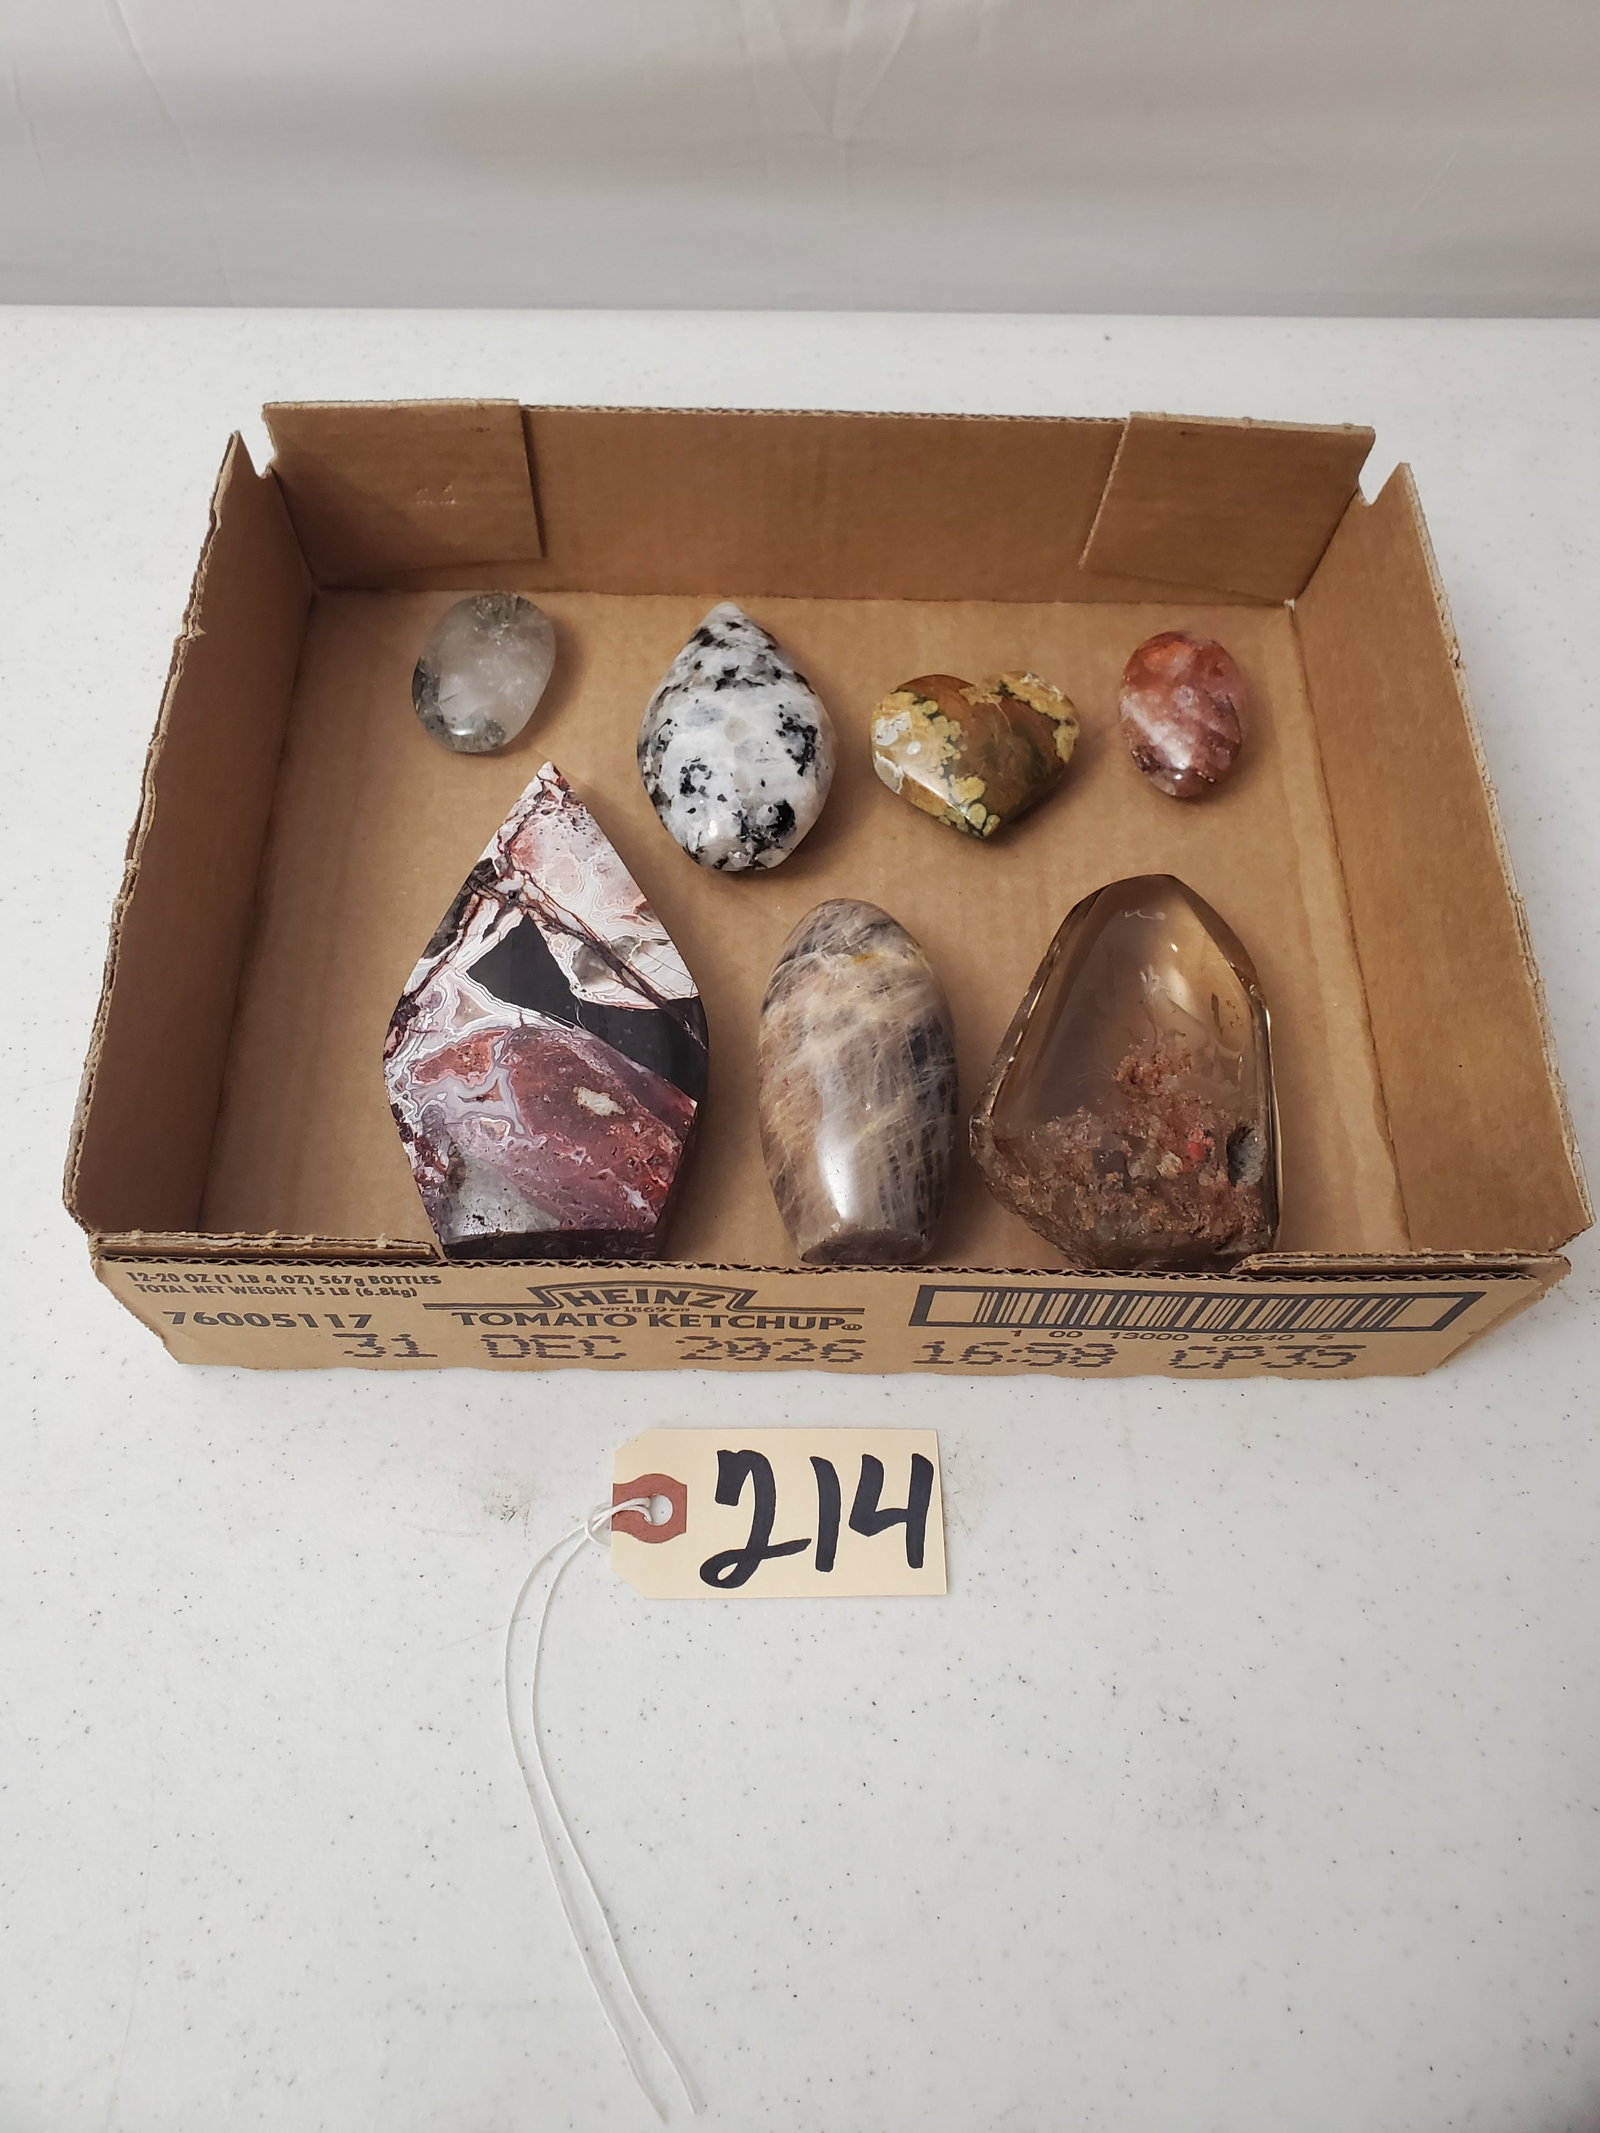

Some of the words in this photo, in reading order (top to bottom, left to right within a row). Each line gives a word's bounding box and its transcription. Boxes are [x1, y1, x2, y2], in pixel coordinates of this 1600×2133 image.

[126, 1272, 180, 1282] 12-20
[184, 1273, 211, 1283] OZ
[215, 1274, 233, 1285] (1
[238, 1274, 259, 1284] LB
[265, 1274, 277, 1284] 4
[281, 1275, 315, 1285] OZ)
[319, 1275, 365, 1287] 567g
[368, 1275, 441, 1285] BOTTLES
[134, 1284, 190, 1293] TOTAL
[193, 1285, 225, 1294] NET
[228, 1286, 297, 1295] WEIGHT
[302, 1287, 325, 1295] 15
[329, 1287, 350, 1295] LB
[355, 1287, 417, 1298] (6.8kg)
[558, 1288, 725, 1308] HEINZ
[162, 1311, 372, 1328] 76005117
[451, 1312, 637, 1327] TOMATO
[649, 1314, 845, 1330] KETCHUP
[1048, 1330, 1083, 1338] 00
[1110, 1331, 1190, 1341] 13000
[1211, 1334, 1295, 1342] 00640
[1315, 1333, 1337, 1341] 5
[332, 1333, 438, 1358] 31
[480, 1334, 627, 1359] DEC
[675, 1336, 866, 1362] 2026
[1168, 1345, 1368, 1369] CP35
[699, 1449, 935, 1590] 214
